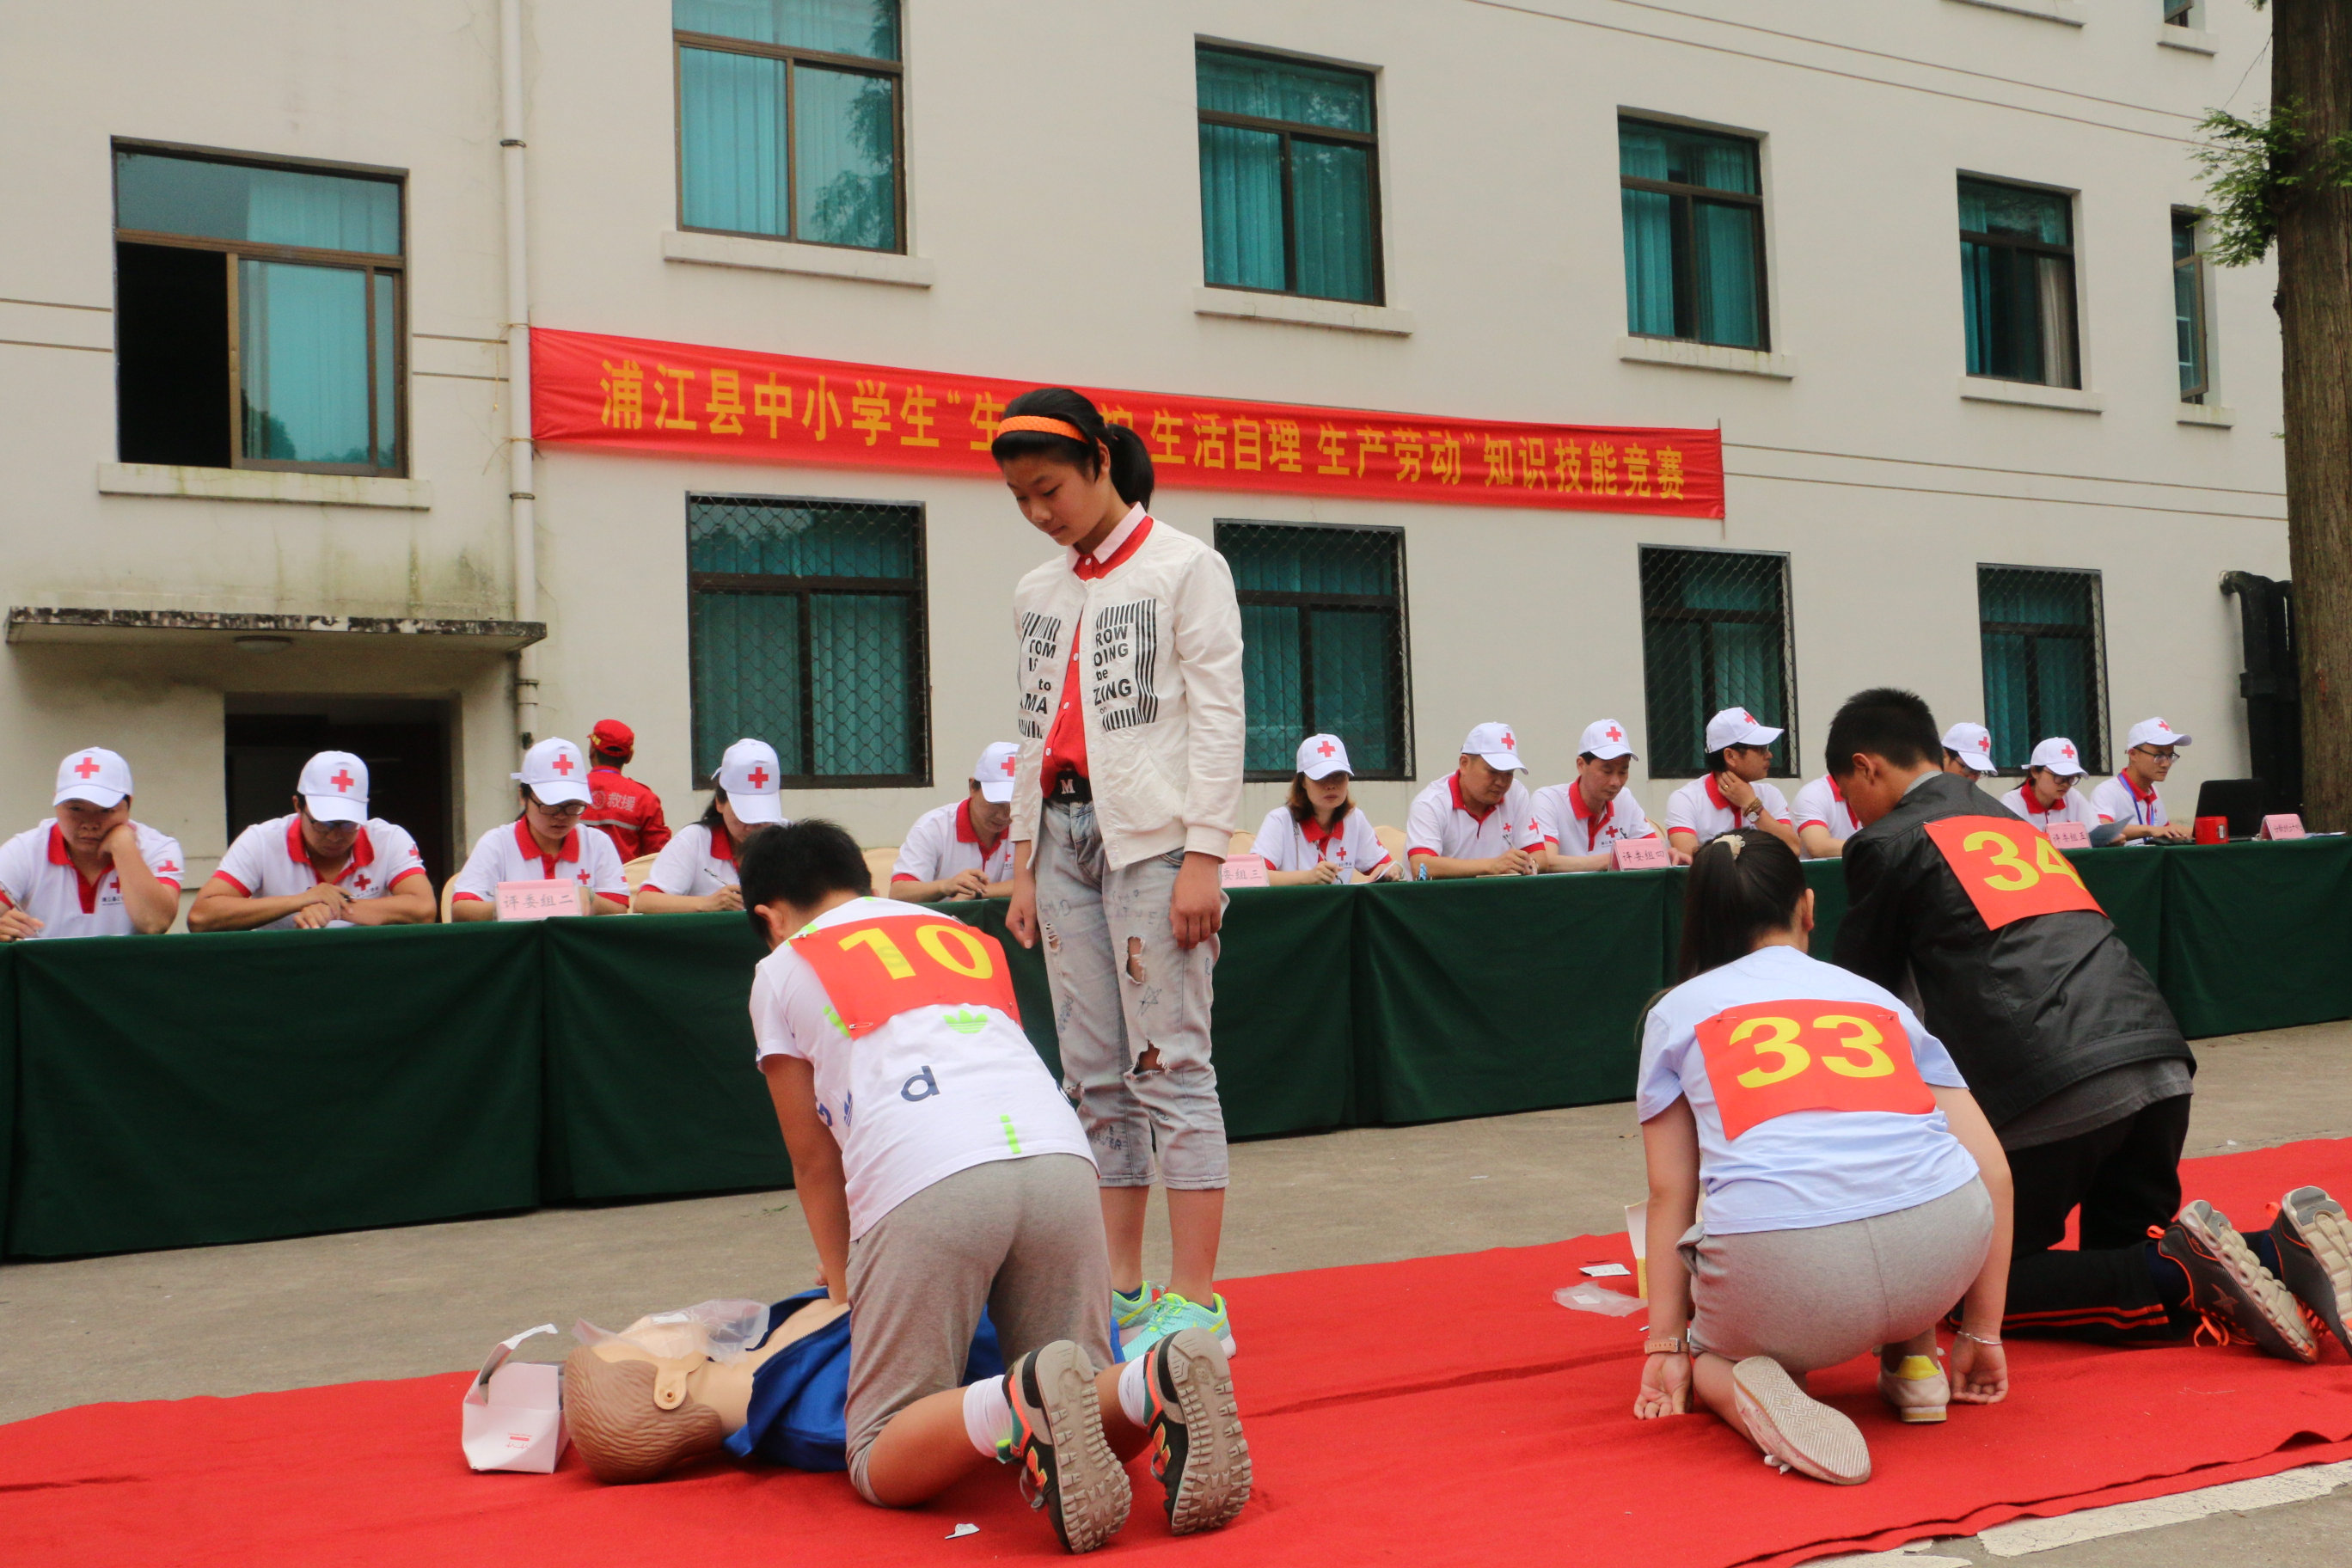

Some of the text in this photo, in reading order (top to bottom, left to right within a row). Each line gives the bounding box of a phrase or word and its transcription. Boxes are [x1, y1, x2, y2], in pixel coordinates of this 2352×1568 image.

[1094, 625, 1129, 648] ROW
[1038, 677, 1051, 691] to
[1095, 669, 1108, 681] be
[1092, 678, 1132, 707] ZING
[1060, 778, 1075, 794] M
[608, 792, 636, 812] 救援
[1963, 830, 2089, 892] 34
[1222, 867, 1263, 881] 委组三
[503, 893, 574, 911] 评委组二
[837, 924, 994, 980] 10
[1729, 1014, 1896, 1089] 33
[900, 1065, 940, 1102] d
